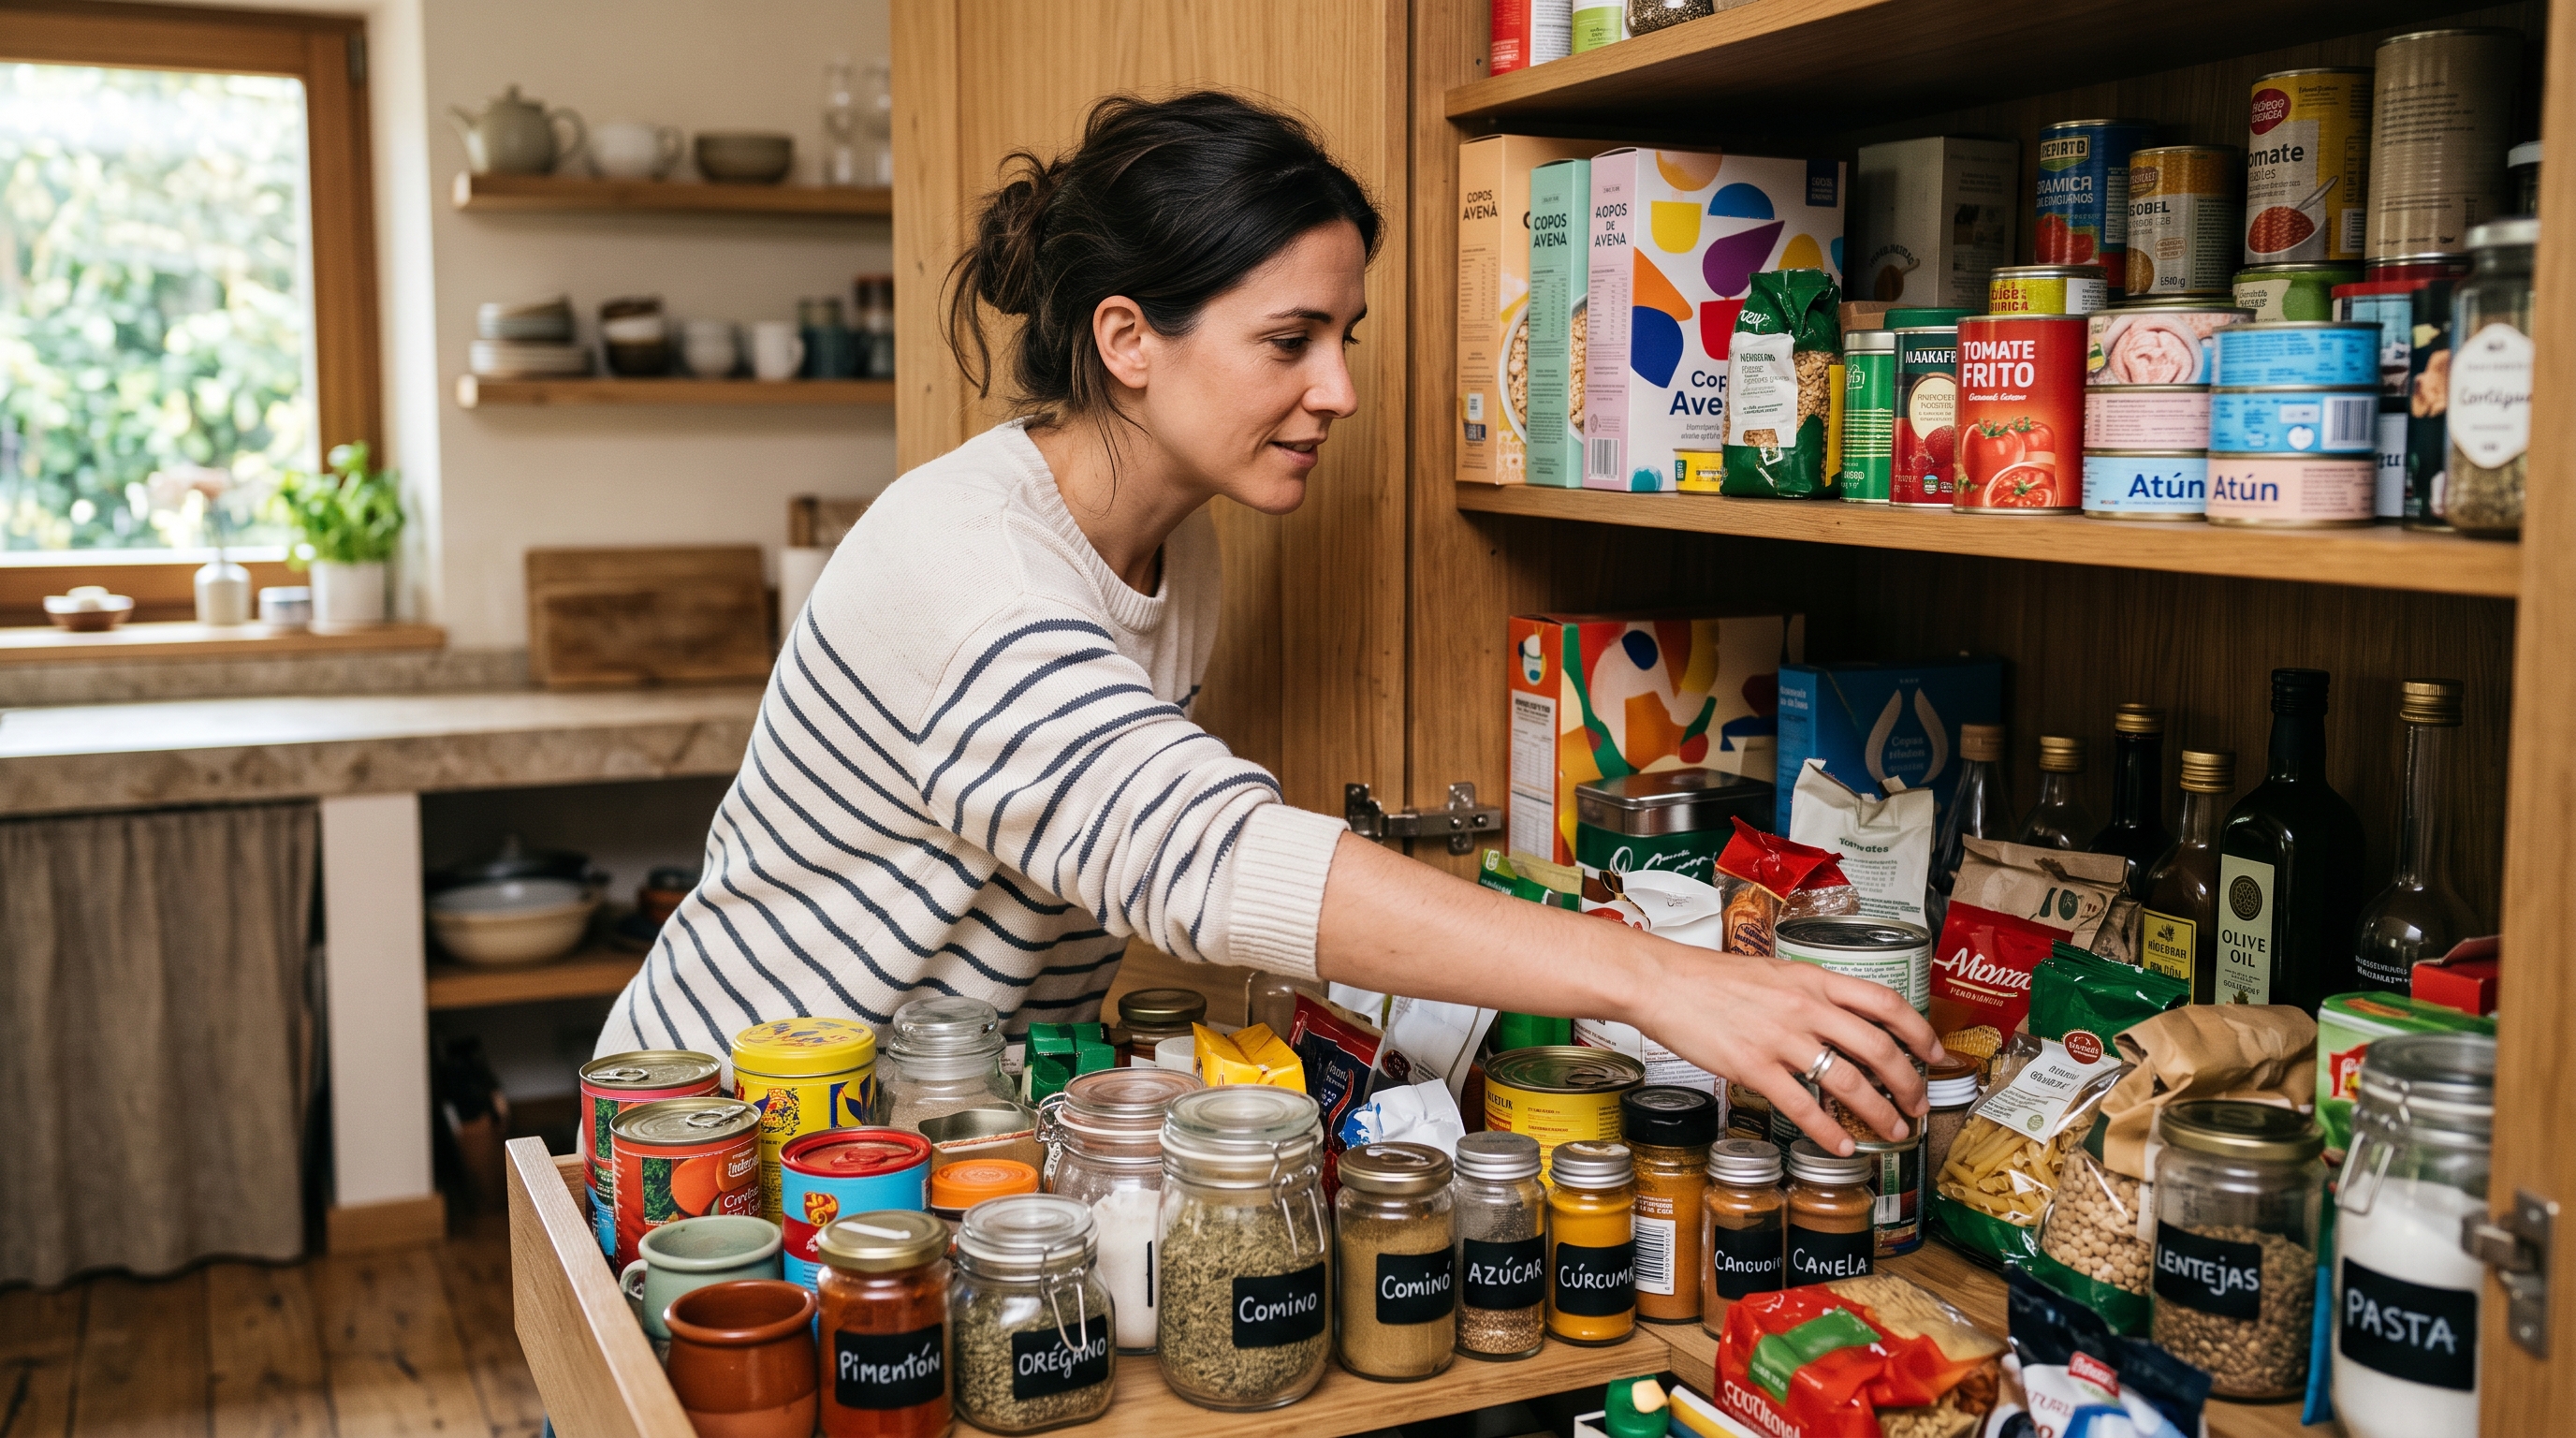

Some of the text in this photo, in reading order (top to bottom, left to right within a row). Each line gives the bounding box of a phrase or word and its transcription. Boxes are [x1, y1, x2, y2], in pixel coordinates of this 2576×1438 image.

[2248, 143, 2305, 169] omate
[1467, 190, 1493, 203] COPOS
[1534, 213, 1567, 230] COPOS
[1605, 221, 1616, 230] DE
[1533, 231, 1568, 248] AVENA
[1594, 232, 1627, 247] AVENA
[1962, 340, 2036, 361] TOMATE
[1690, 370, 1727, 393] Cop
[1962, 361, 2035, 388] FRITO
[1669, 390, 1723, 416] Ave
[2128, 472, 2205, 499] Atún
[2213, 473, 2279, 501] Atún
[2221, 929, 2266, 953] OLIVE
[2230, 949, 2256, 968] OIL
[1468, 1255, 1543, 1286] AZÚCAR
[2346, 1286, 2459, 1356] PASTA
[839, 1342, 941, 1385] Pimentón
